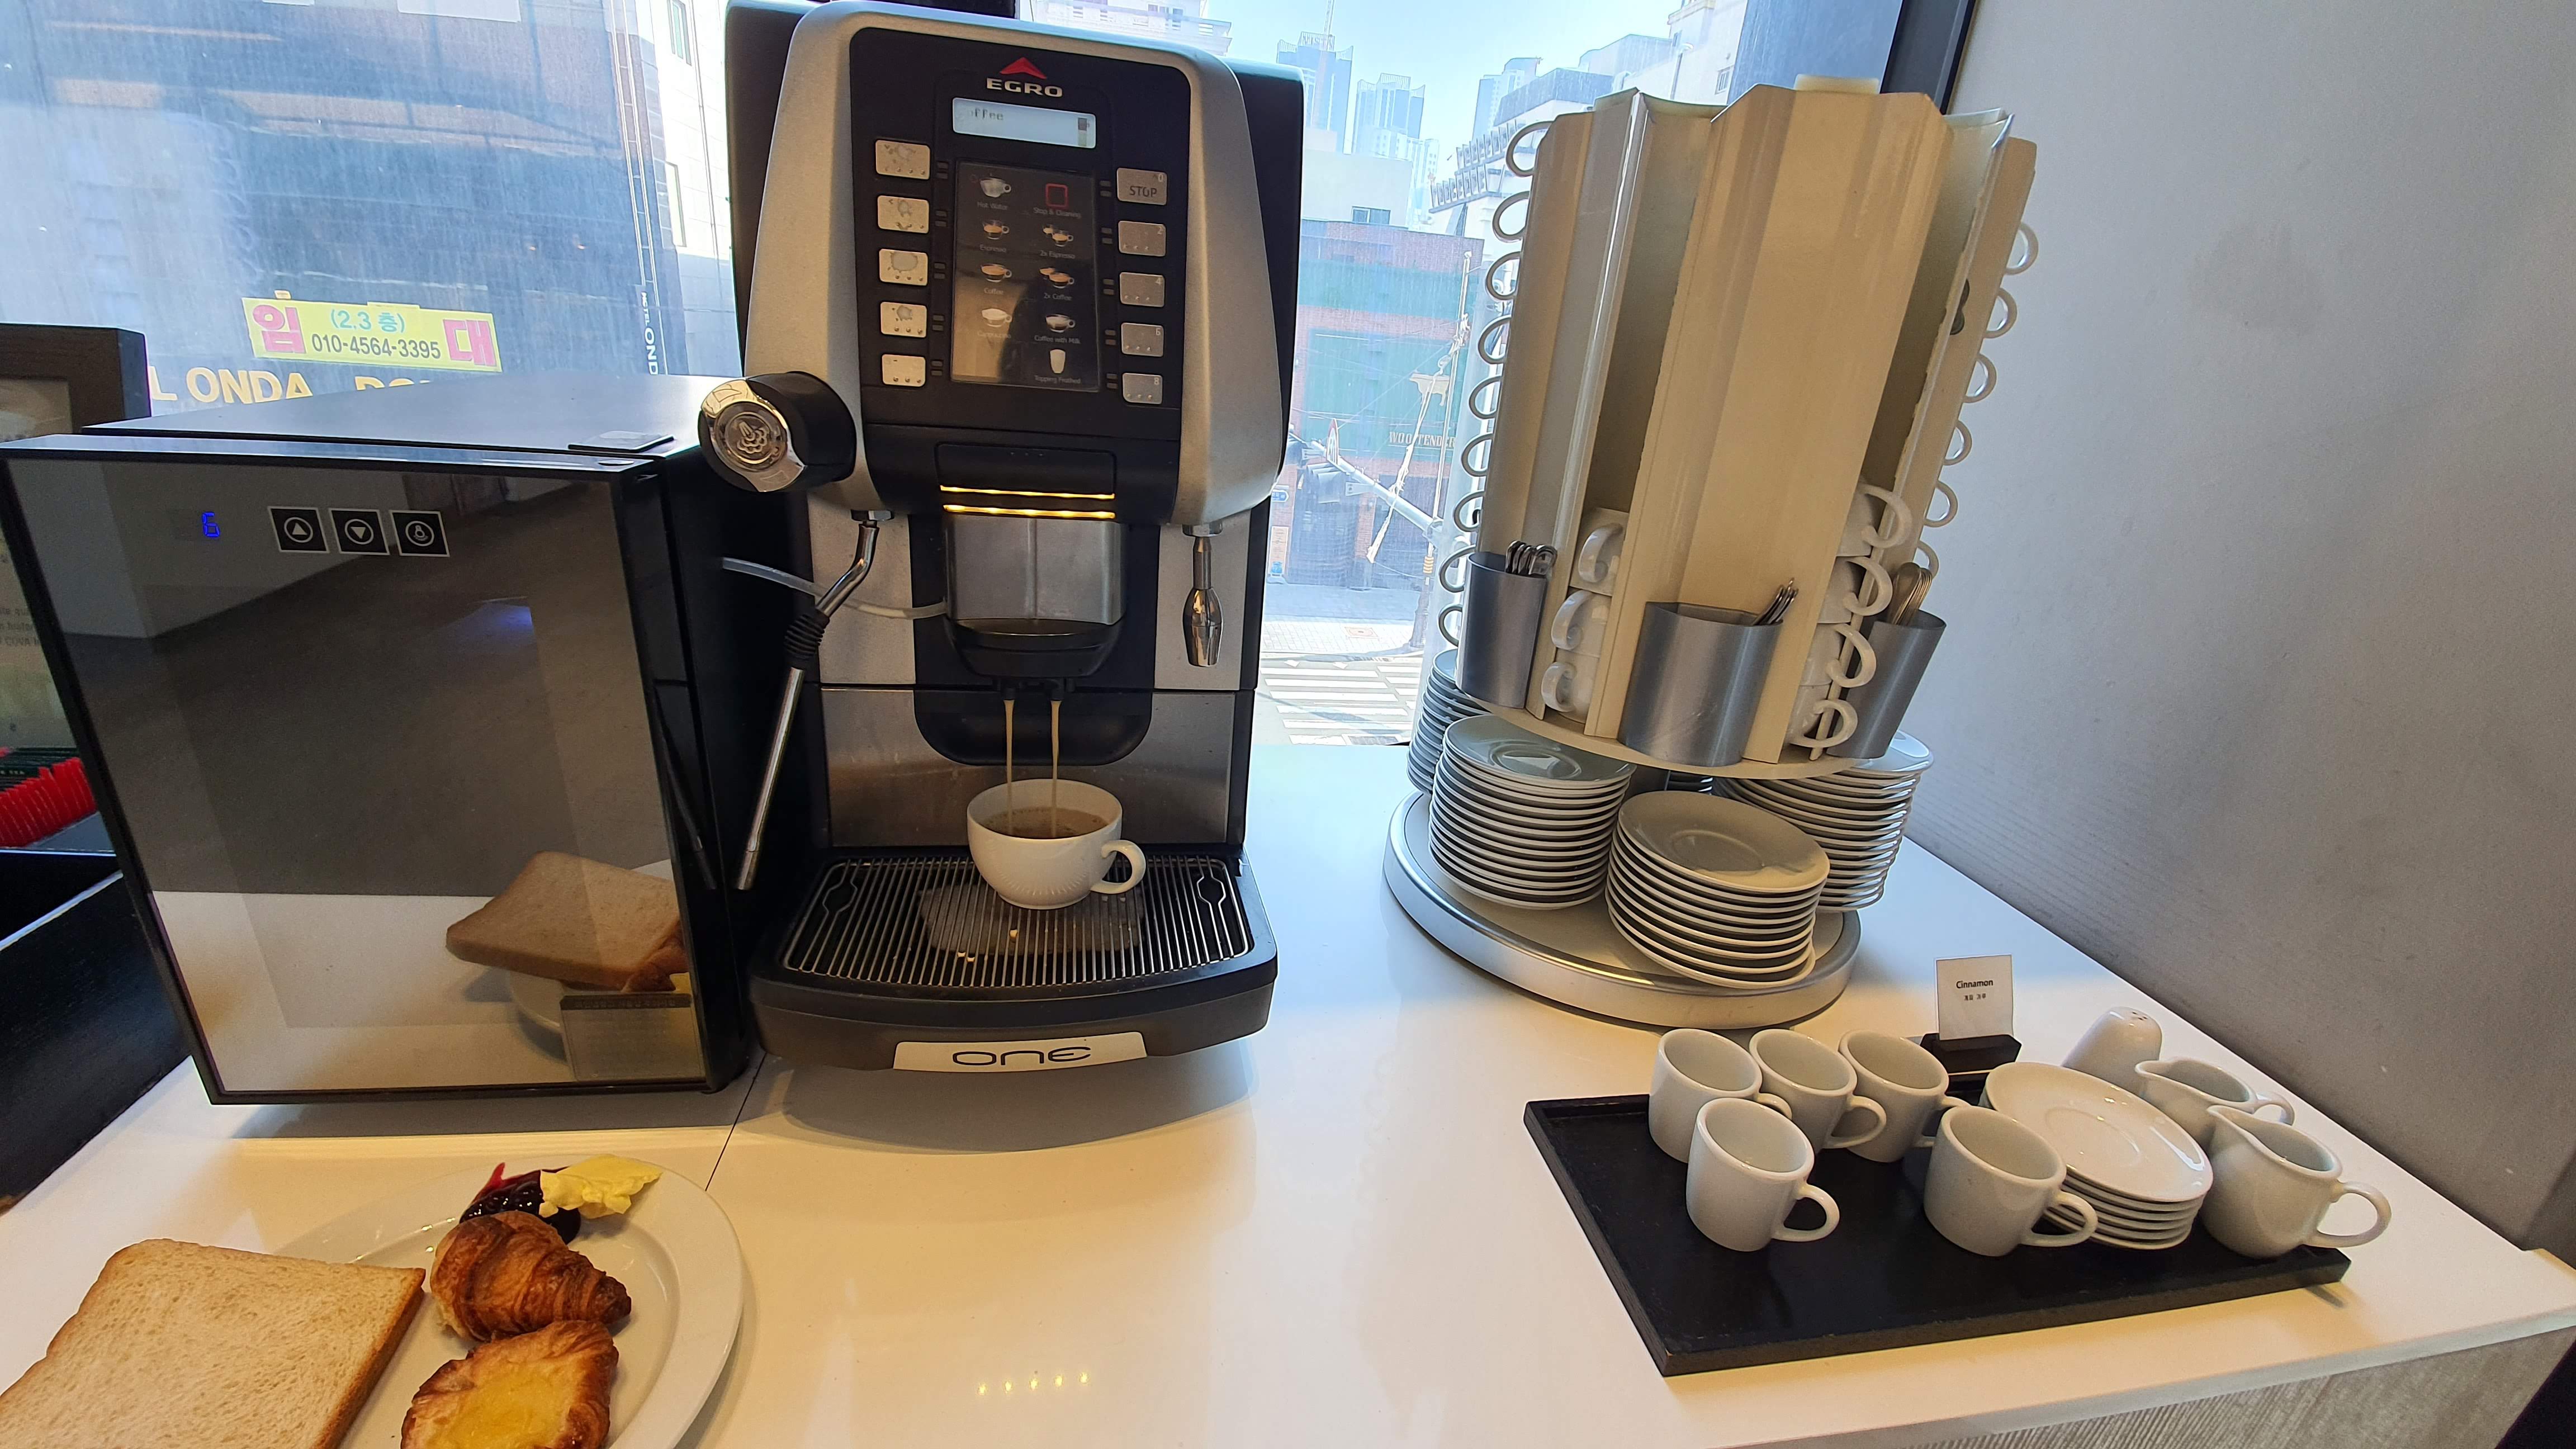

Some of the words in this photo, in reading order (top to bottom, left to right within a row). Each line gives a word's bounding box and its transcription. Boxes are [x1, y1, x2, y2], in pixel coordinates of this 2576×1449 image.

[987, 78, 1063, 97] EGRO
[1129, 186, 1157, 197] STOP
[1157, 226, 1163, 235] 2
[1049, 251, 1076, 259] Espresso
[984, 287, 1005, 295] Coffee
[253, 305, 306, 354] 임
[443, 319, 497, 367] 대
[1034, 335, 1053, 343] Coffee
[311, 333, 442, 359] 010-4564-3395
[186, 367, 314, 404] ONDA
[1417, 434, 1456, 448] TENDR
[1956, 980, 1993, 988] Cinnamon
